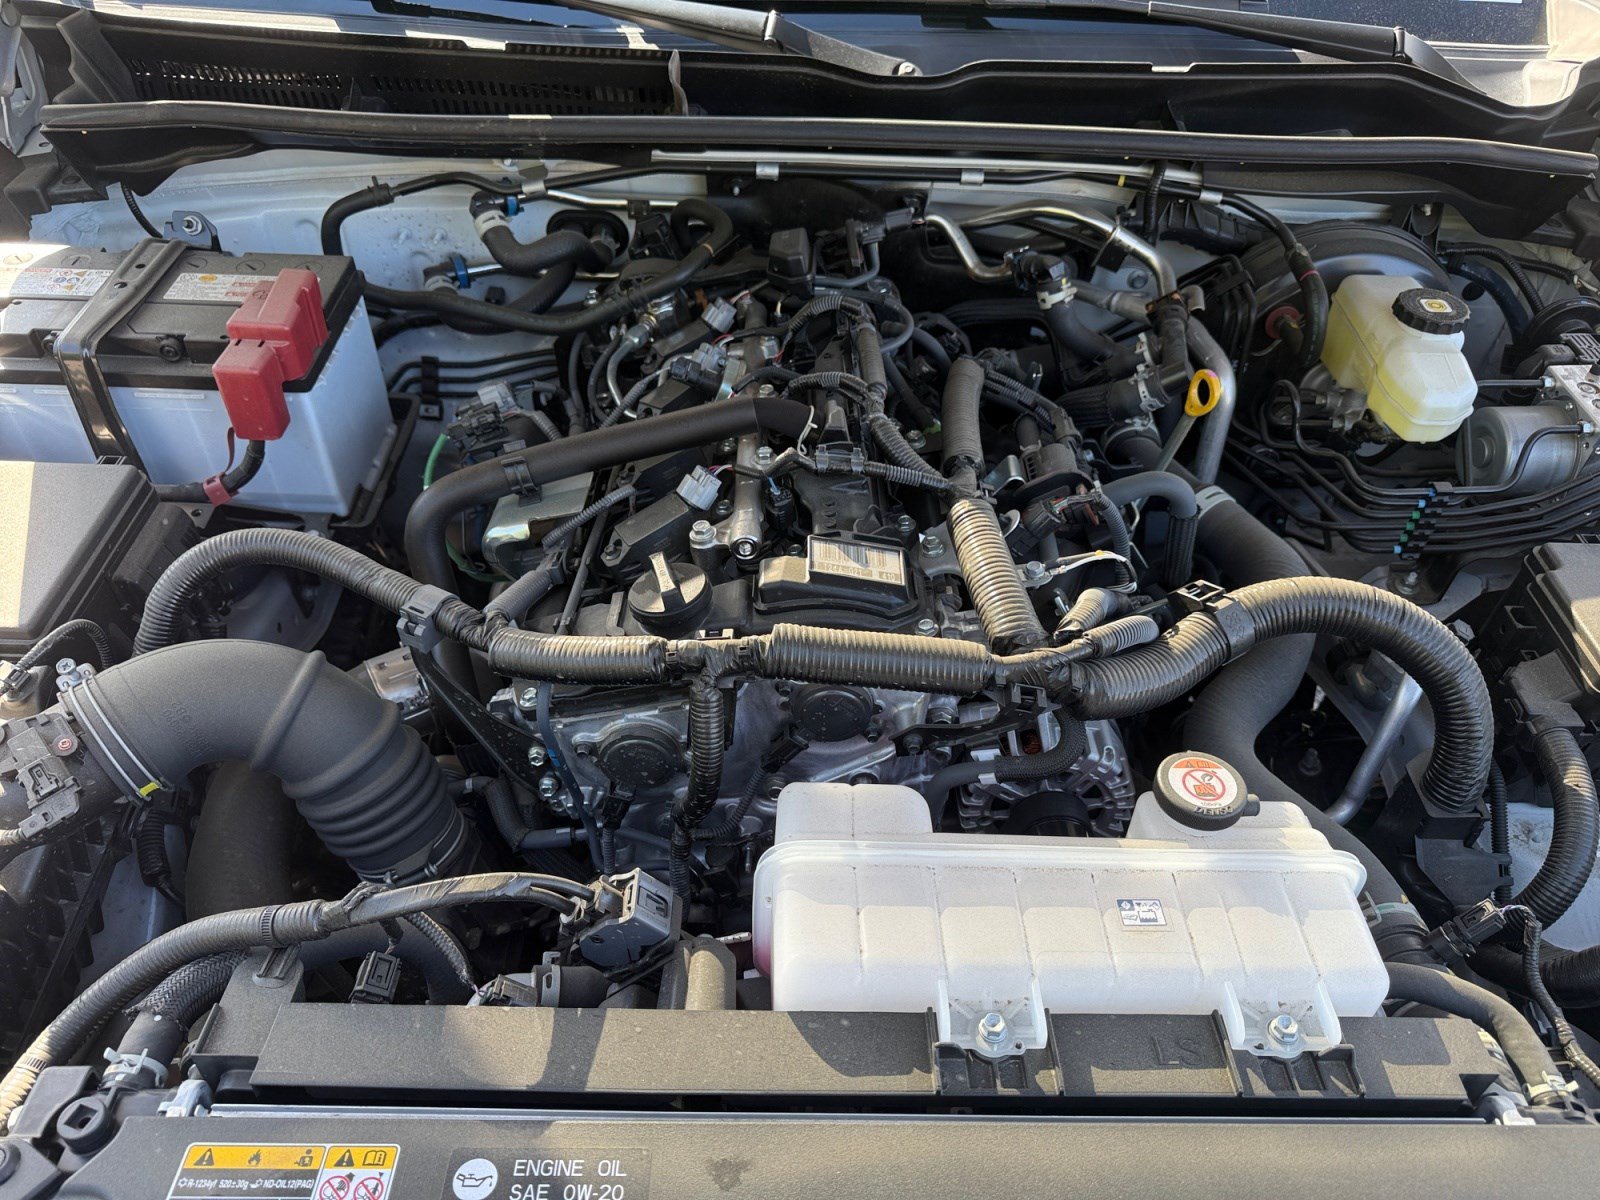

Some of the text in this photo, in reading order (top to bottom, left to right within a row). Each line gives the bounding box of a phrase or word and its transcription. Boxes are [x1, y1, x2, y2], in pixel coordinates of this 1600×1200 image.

[513, 1159, 627, 1177] ENGINE OIL
[187, 1178, 315, 1190] R-1234yf 520±30g ND-OIL12(PAG)
[509, 1183, 625, 1200] SAE 0W-20
